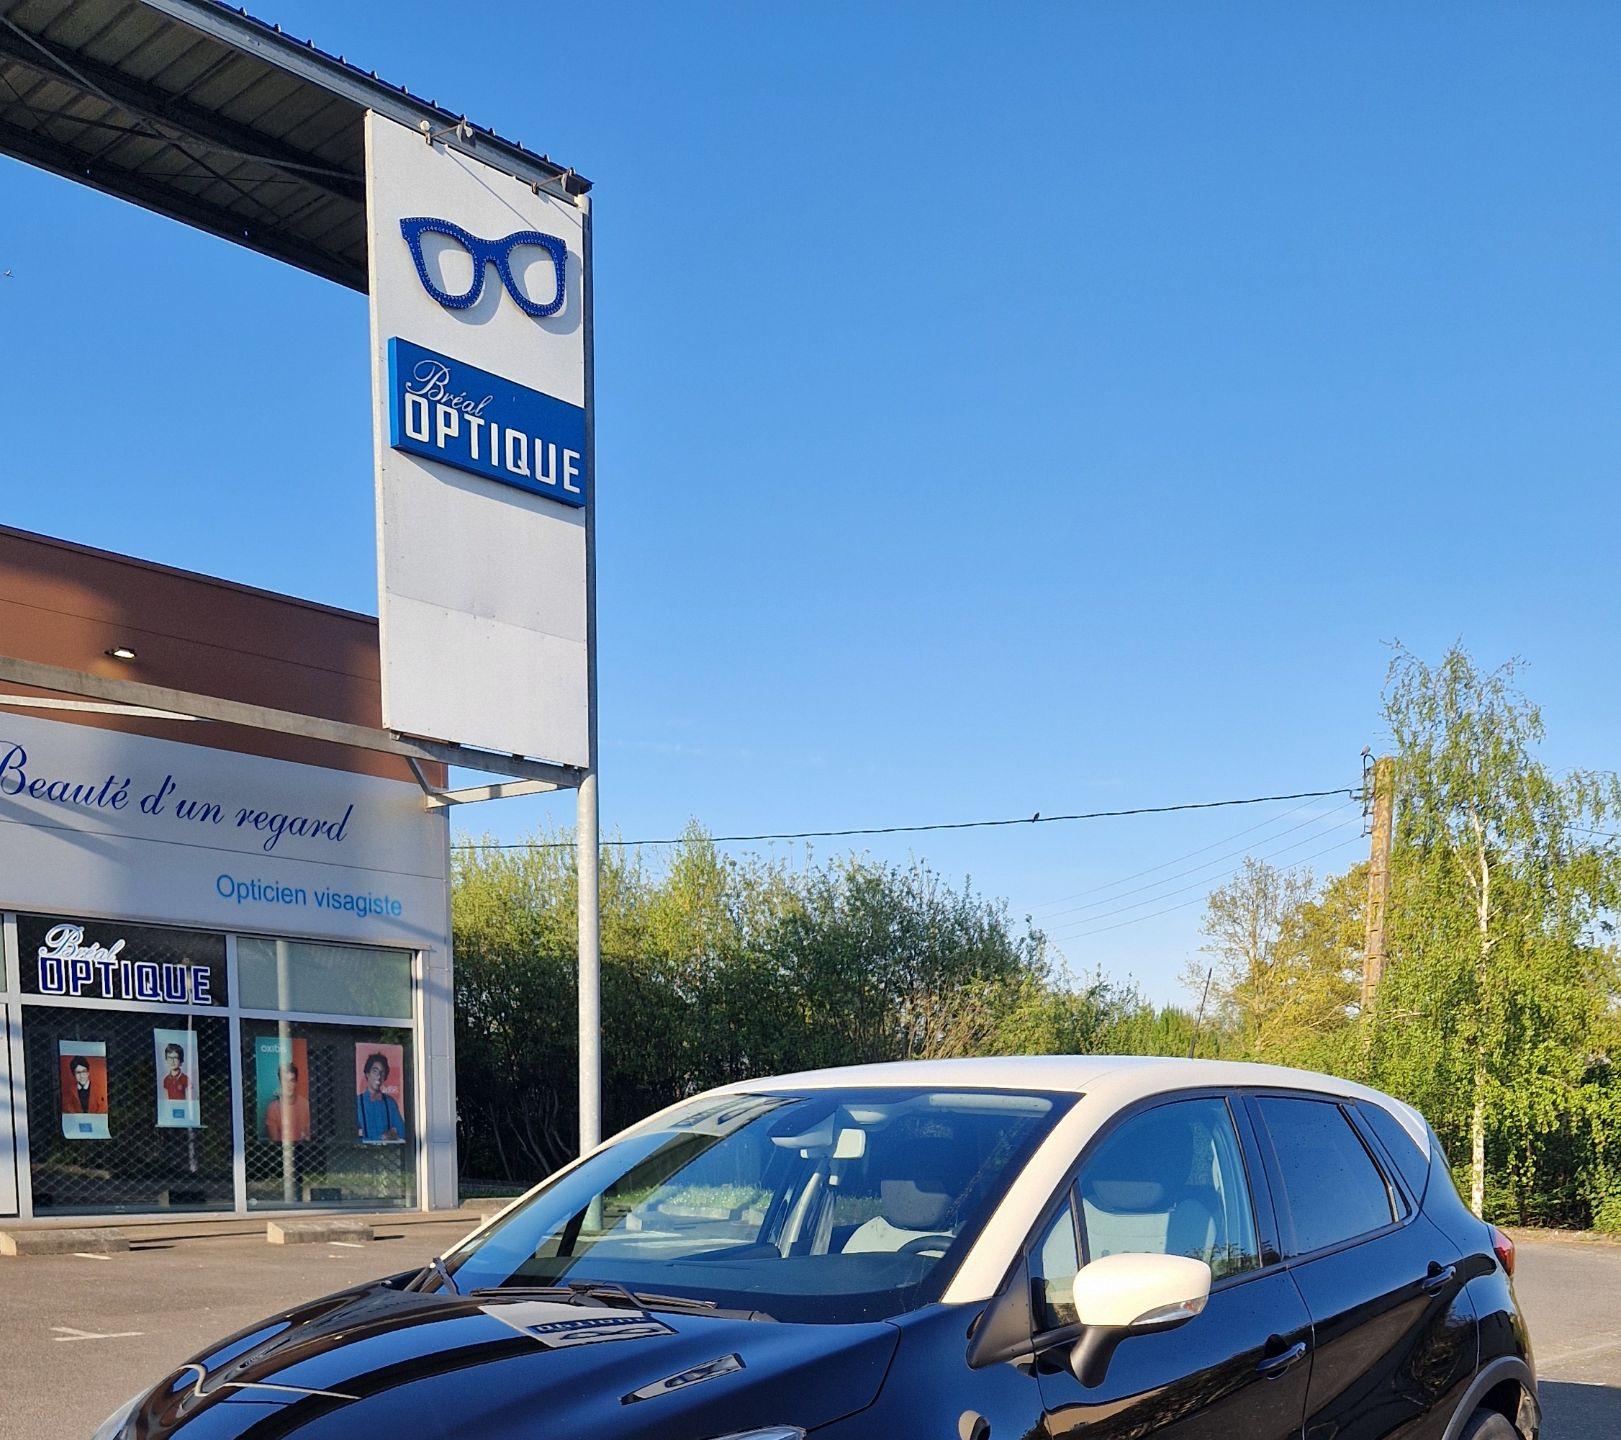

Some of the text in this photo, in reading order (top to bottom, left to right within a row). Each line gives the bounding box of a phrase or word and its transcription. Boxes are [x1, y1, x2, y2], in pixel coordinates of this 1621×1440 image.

[405, 360, 493, 416] Bréal
[405, 392, 581, 493] OPTIQUE
[0, 741, 354, 851] Beauté d'un regard
[216, 874, 402, 918] Opticien visagiste
[38, 956, 212, 1004] OPTIQUE
